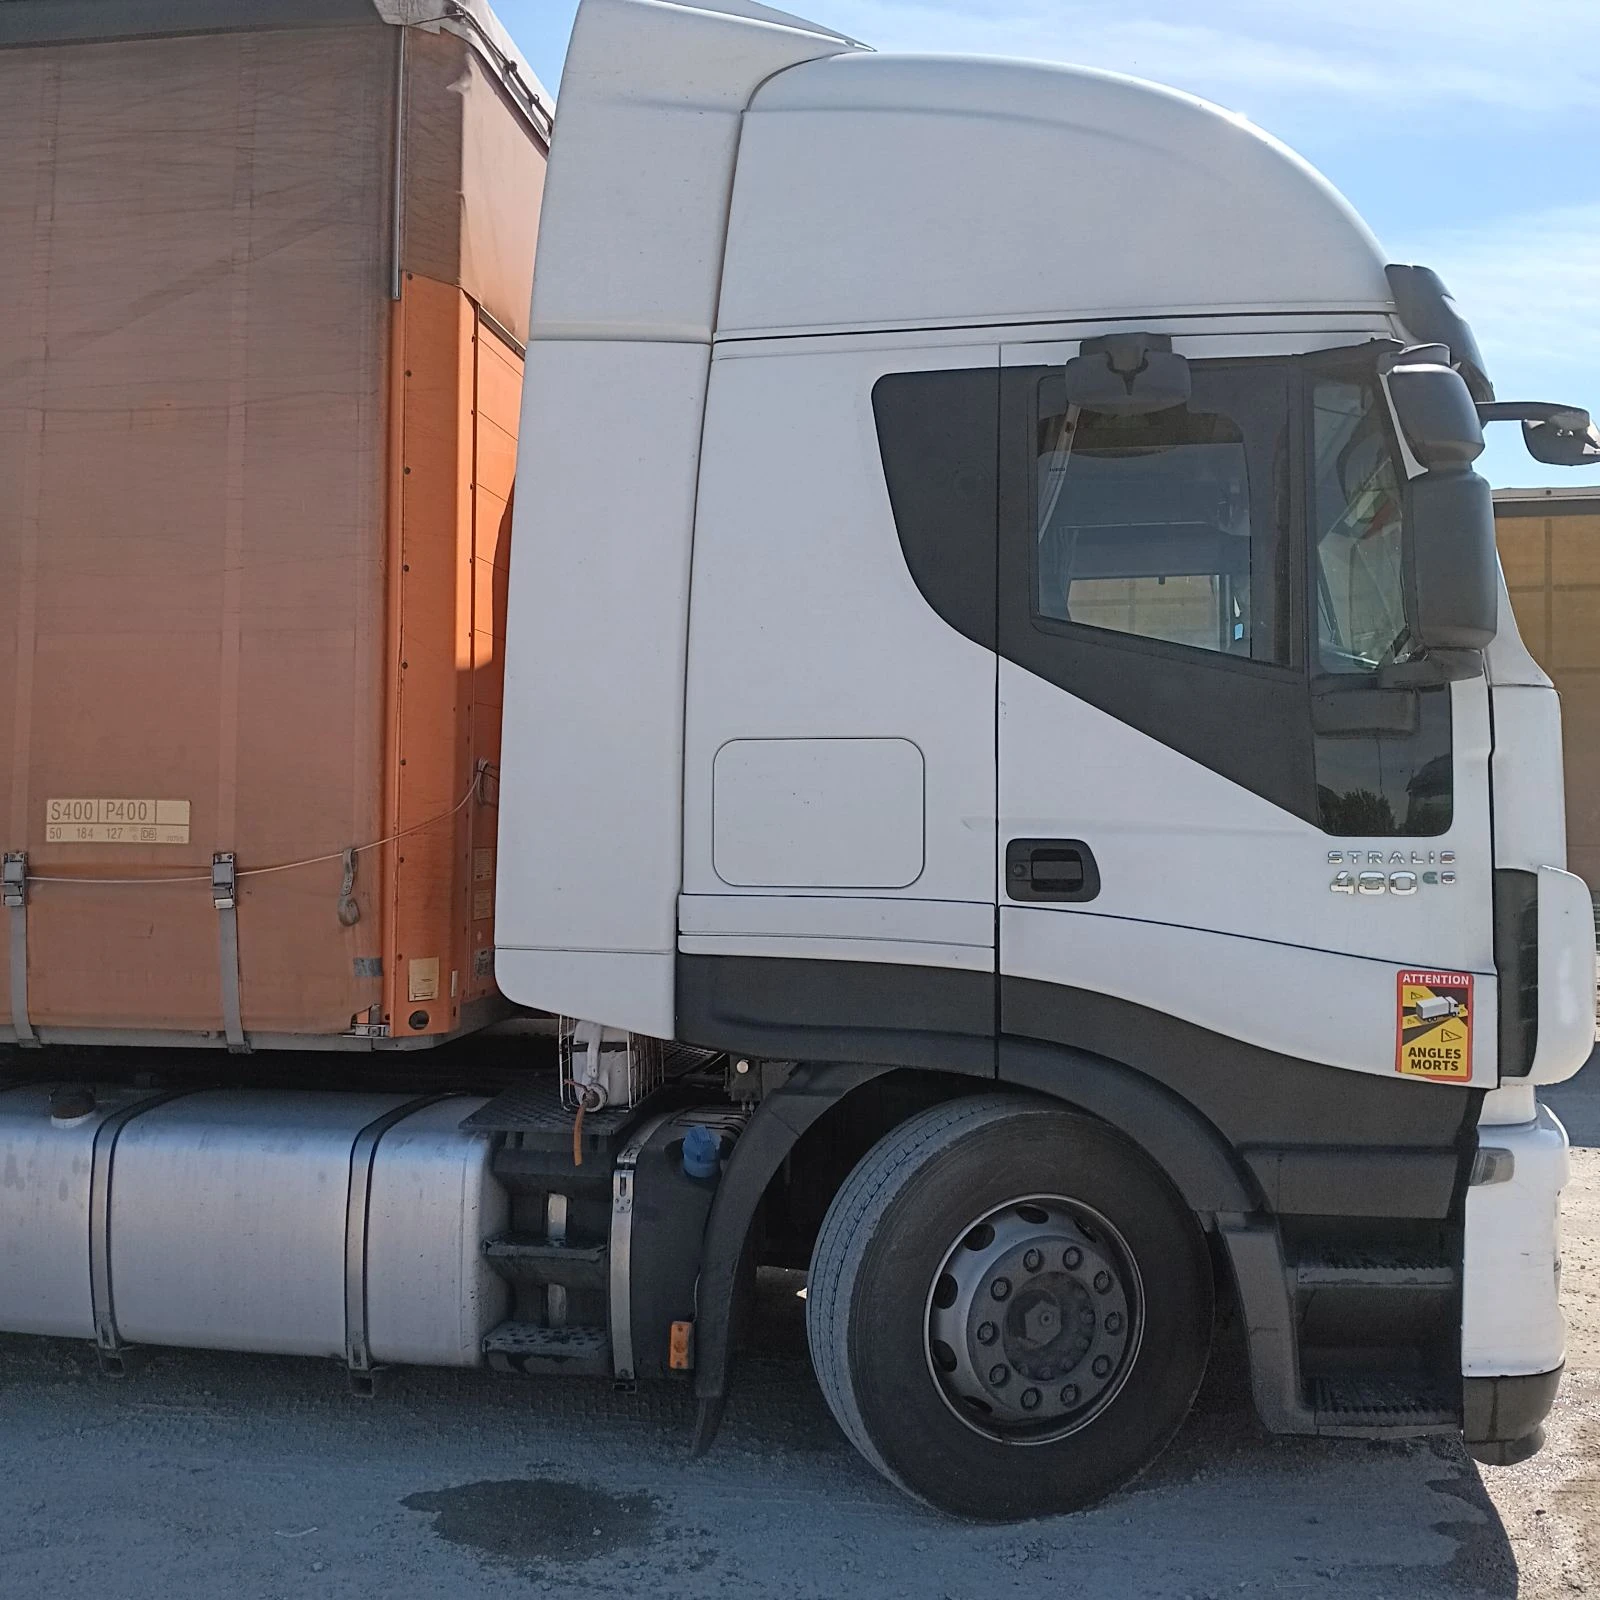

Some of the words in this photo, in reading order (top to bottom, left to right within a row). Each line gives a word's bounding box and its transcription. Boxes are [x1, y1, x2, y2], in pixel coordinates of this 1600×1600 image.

[51, 801, 93, 820] S400
[105, 801, 148, 821] P400
[50, 827, 62, 839] 50
[77, 827, 94, 839] 184
[106, 827, 124, 839] 127
[1327, 850, 1456, 864] STRALIS
[1402, 973, 1470, 985] ATTENTION
[1408, 1046, 1462, 1060] ANGLES
[1410, 1058, 1459, 1071] MORTS
